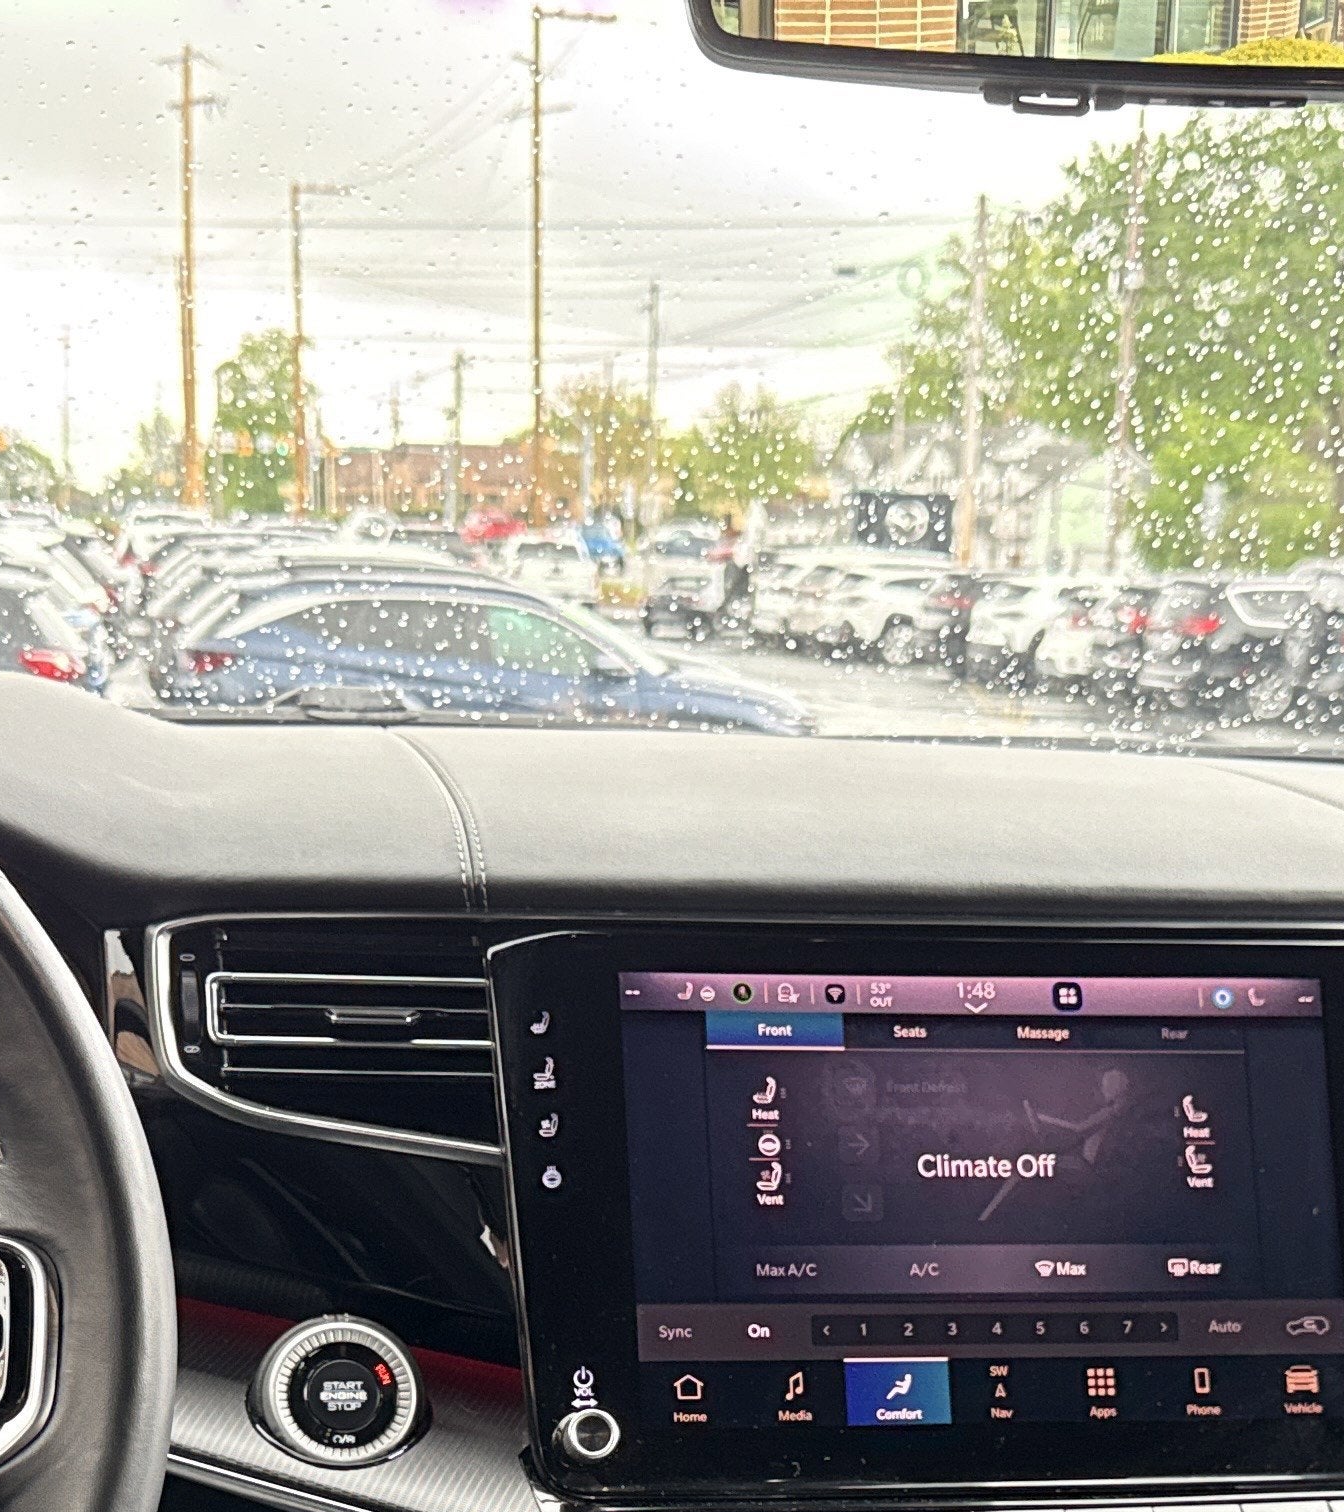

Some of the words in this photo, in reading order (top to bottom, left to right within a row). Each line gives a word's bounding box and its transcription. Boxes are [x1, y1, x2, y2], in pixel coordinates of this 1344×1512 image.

[957, 982, 996, 999] 1:48
[869, 997, 893, 1008] OUT
[758, 1023, 792, 1038] Front
[893, 1025, 927, 1038] Seats
[1017, 1026, 1070, 1042] Massage
[1161, 1027, 1189, 1040] Rear
[752, 1108, 779, 1120] Heat
[917, 1153, 1012, 1178] Climate
[1016, 1153, 1057, 1178] Off
[1186, 1176, 1214, 1188] Vent
[756, 1193, 785, 1205] Vent
[756, 1263, 786, 1277] Max
[787, 1262, 818, 1278] A/C
[909, 1262, 940, 1277] A/C
[1056, 1262, 1087, 1276] Max
[1189, 1260, 1222, 1275] Rear
[658, 1325, 693, 1340] Sync
[747, 1324, 771, 1339] On
[859, 1322, 868, 1337] 1
[903, 1322, 914, 1337] 2
[947, 1322, 958, 1337] 3
[991, 1321, 1003, 1337] 4
[1035, 1321, 1046, 1336] 5
[1079, 1321, 1090, 1336] 6
[1123, 1320, 1134, 1335] 7
[1209, 1320, 1242, 1335] Auto
[989, 1365, 1009, 1377] SW
[322, 1381, 365, 1390] START
[319, 1391, 368, 1401] ENGINE
[327, 1401, 362, 1411] STOP
[990, 1407, 1014, 1419] Nav
[1089, 1405, 1118, 1420] Apps
[1186, 1403, 1222, 1417] Phone
[1284, 1401, 1323, 1415] Vehicle
[673, 1411, 708, 1424] Home
[778, 1409, 813, 1422] Media
[875, 1407, 924, 1421] Comfort
